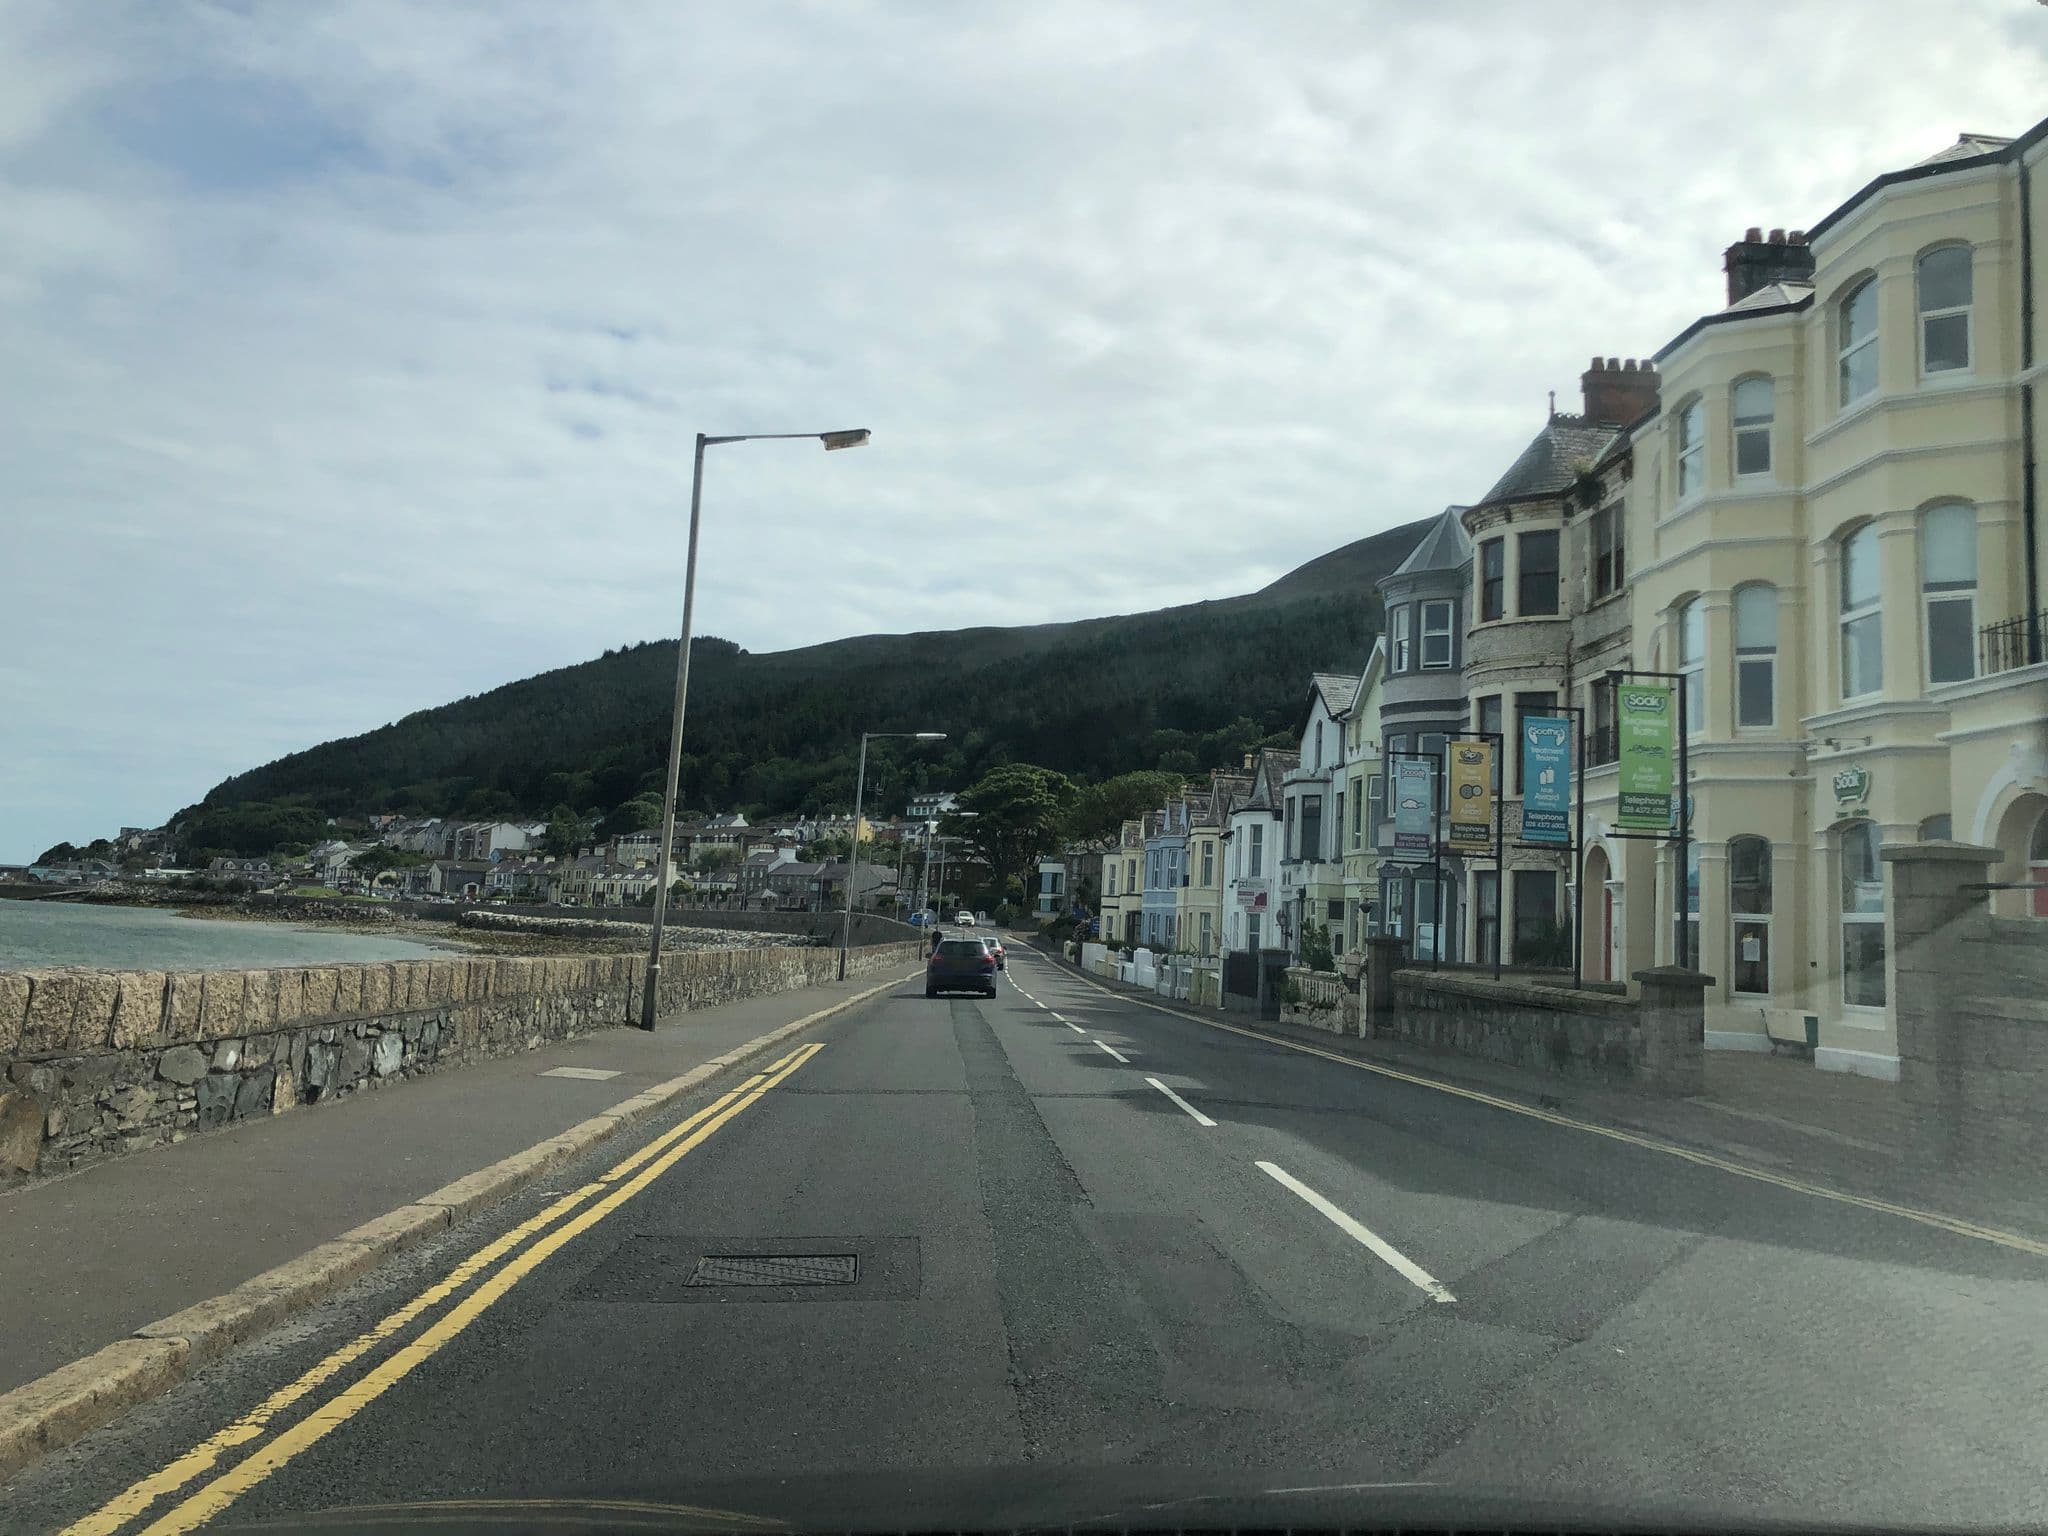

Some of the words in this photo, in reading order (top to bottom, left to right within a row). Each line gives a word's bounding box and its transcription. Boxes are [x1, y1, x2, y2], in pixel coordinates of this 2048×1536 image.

[1629, 694, 1660, 706] Soak
[1623, 795, 1667, 806] Telephone
[1528, 812, 1564, 821] Telephone
